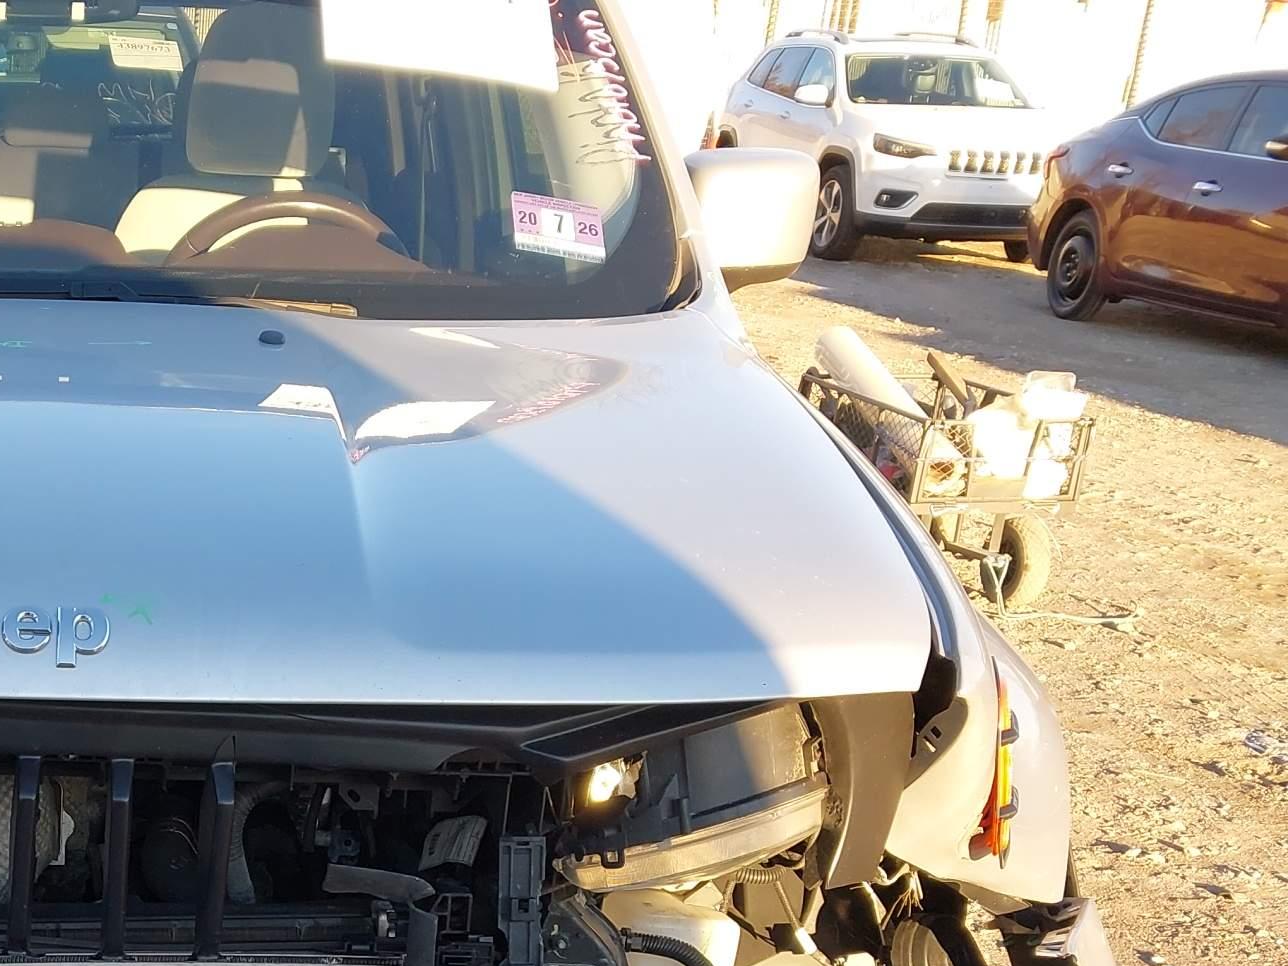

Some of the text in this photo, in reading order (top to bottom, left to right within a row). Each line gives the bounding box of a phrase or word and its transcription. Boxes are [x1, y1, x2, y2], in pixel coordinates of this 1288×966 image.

[518, 210, 599, 237] 20 7 26
